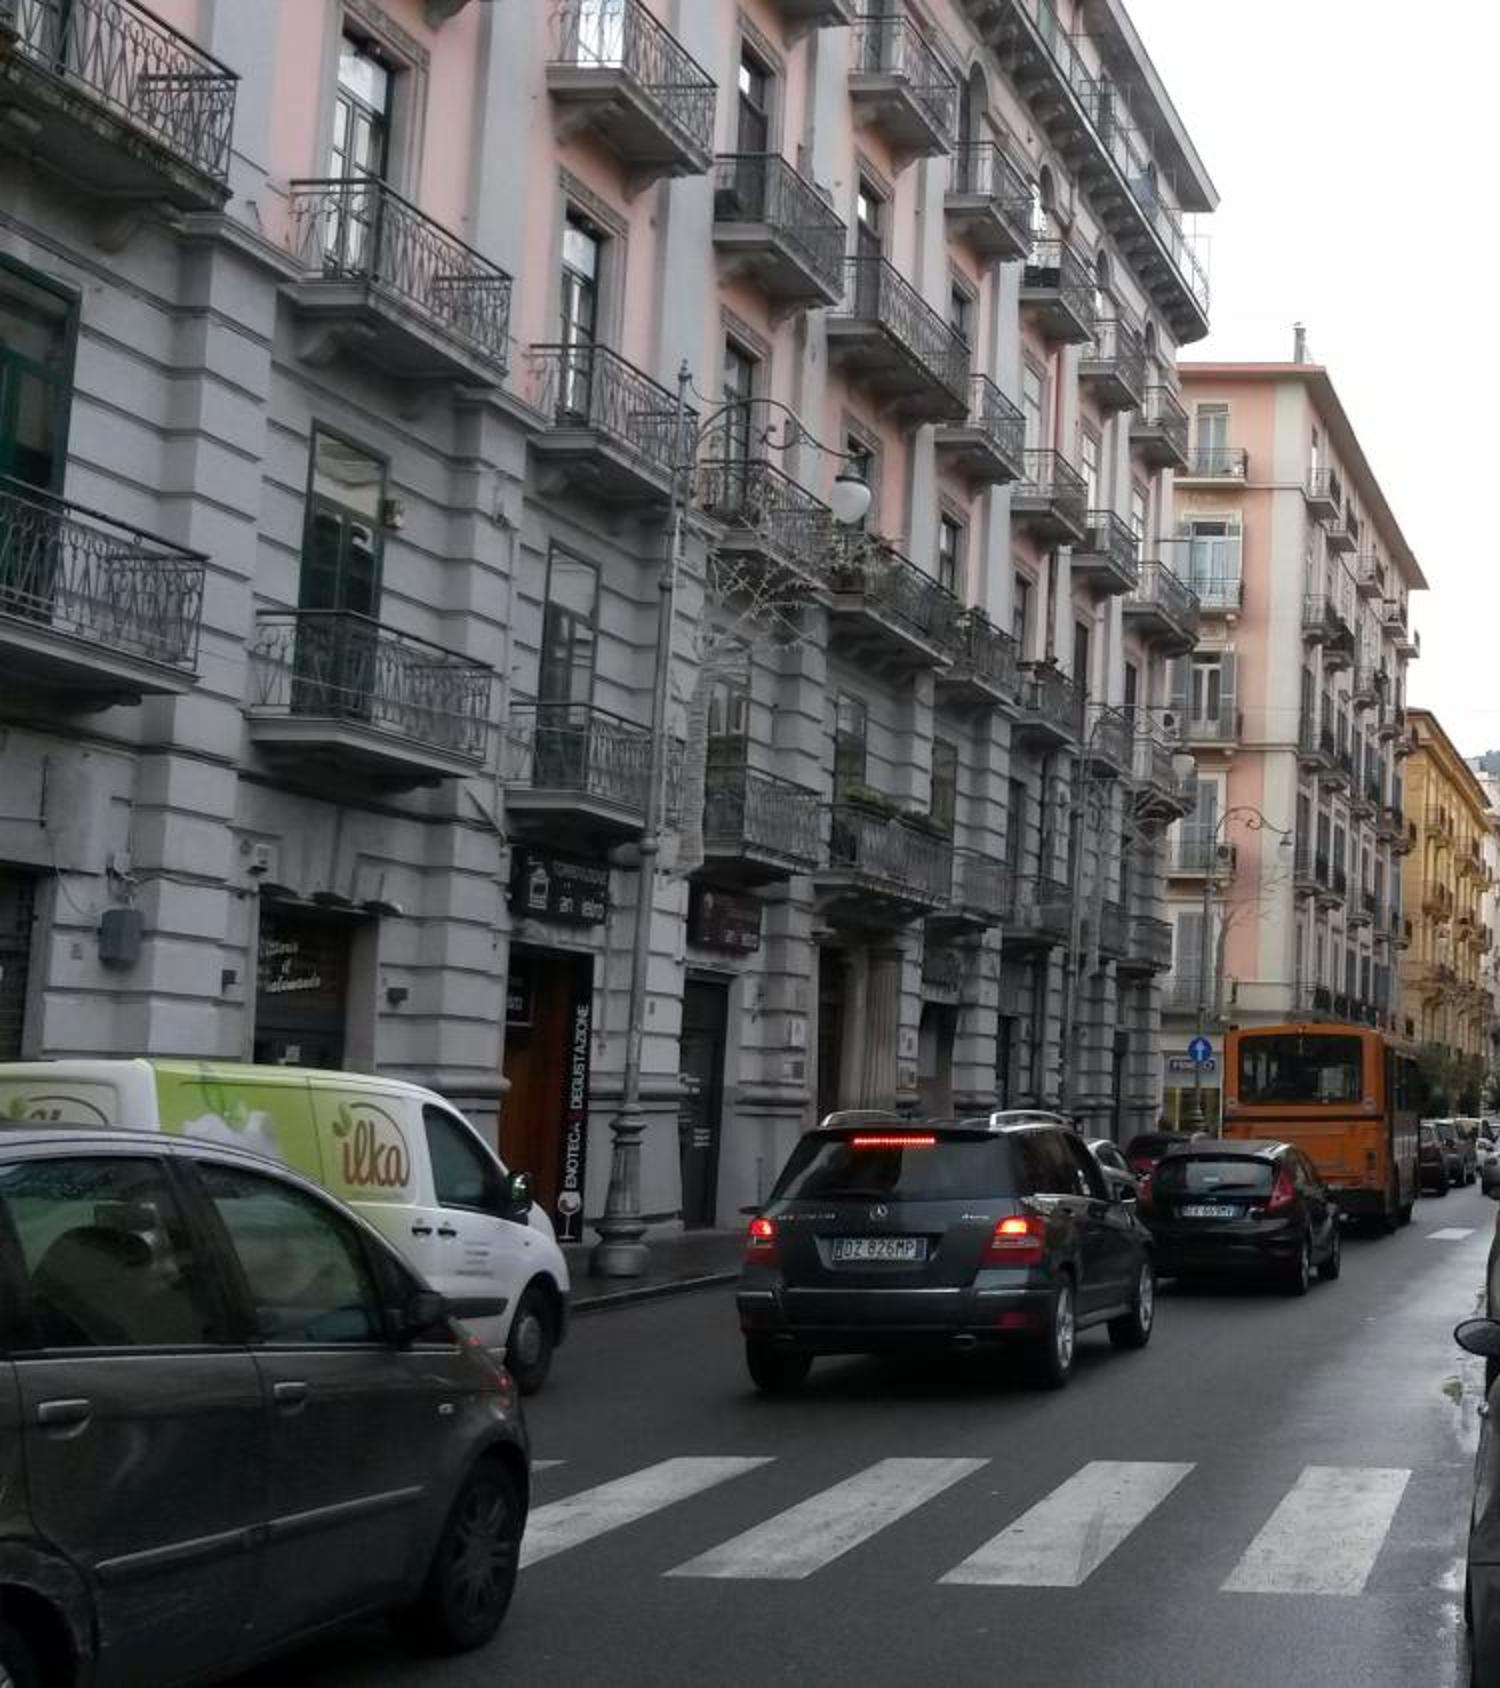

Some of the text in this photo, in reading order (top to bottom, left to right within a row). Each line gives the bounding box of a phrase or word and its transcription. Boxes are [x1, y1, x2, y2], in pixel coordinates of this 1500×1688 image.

[570, 1004, 590, 1109] DEGUSTAZIONE
[342, 1119, 411, 1187] ilka
[564, 1122, 582, 1188] ENOTECA
[844, 1240, 862, 1258] DZ
